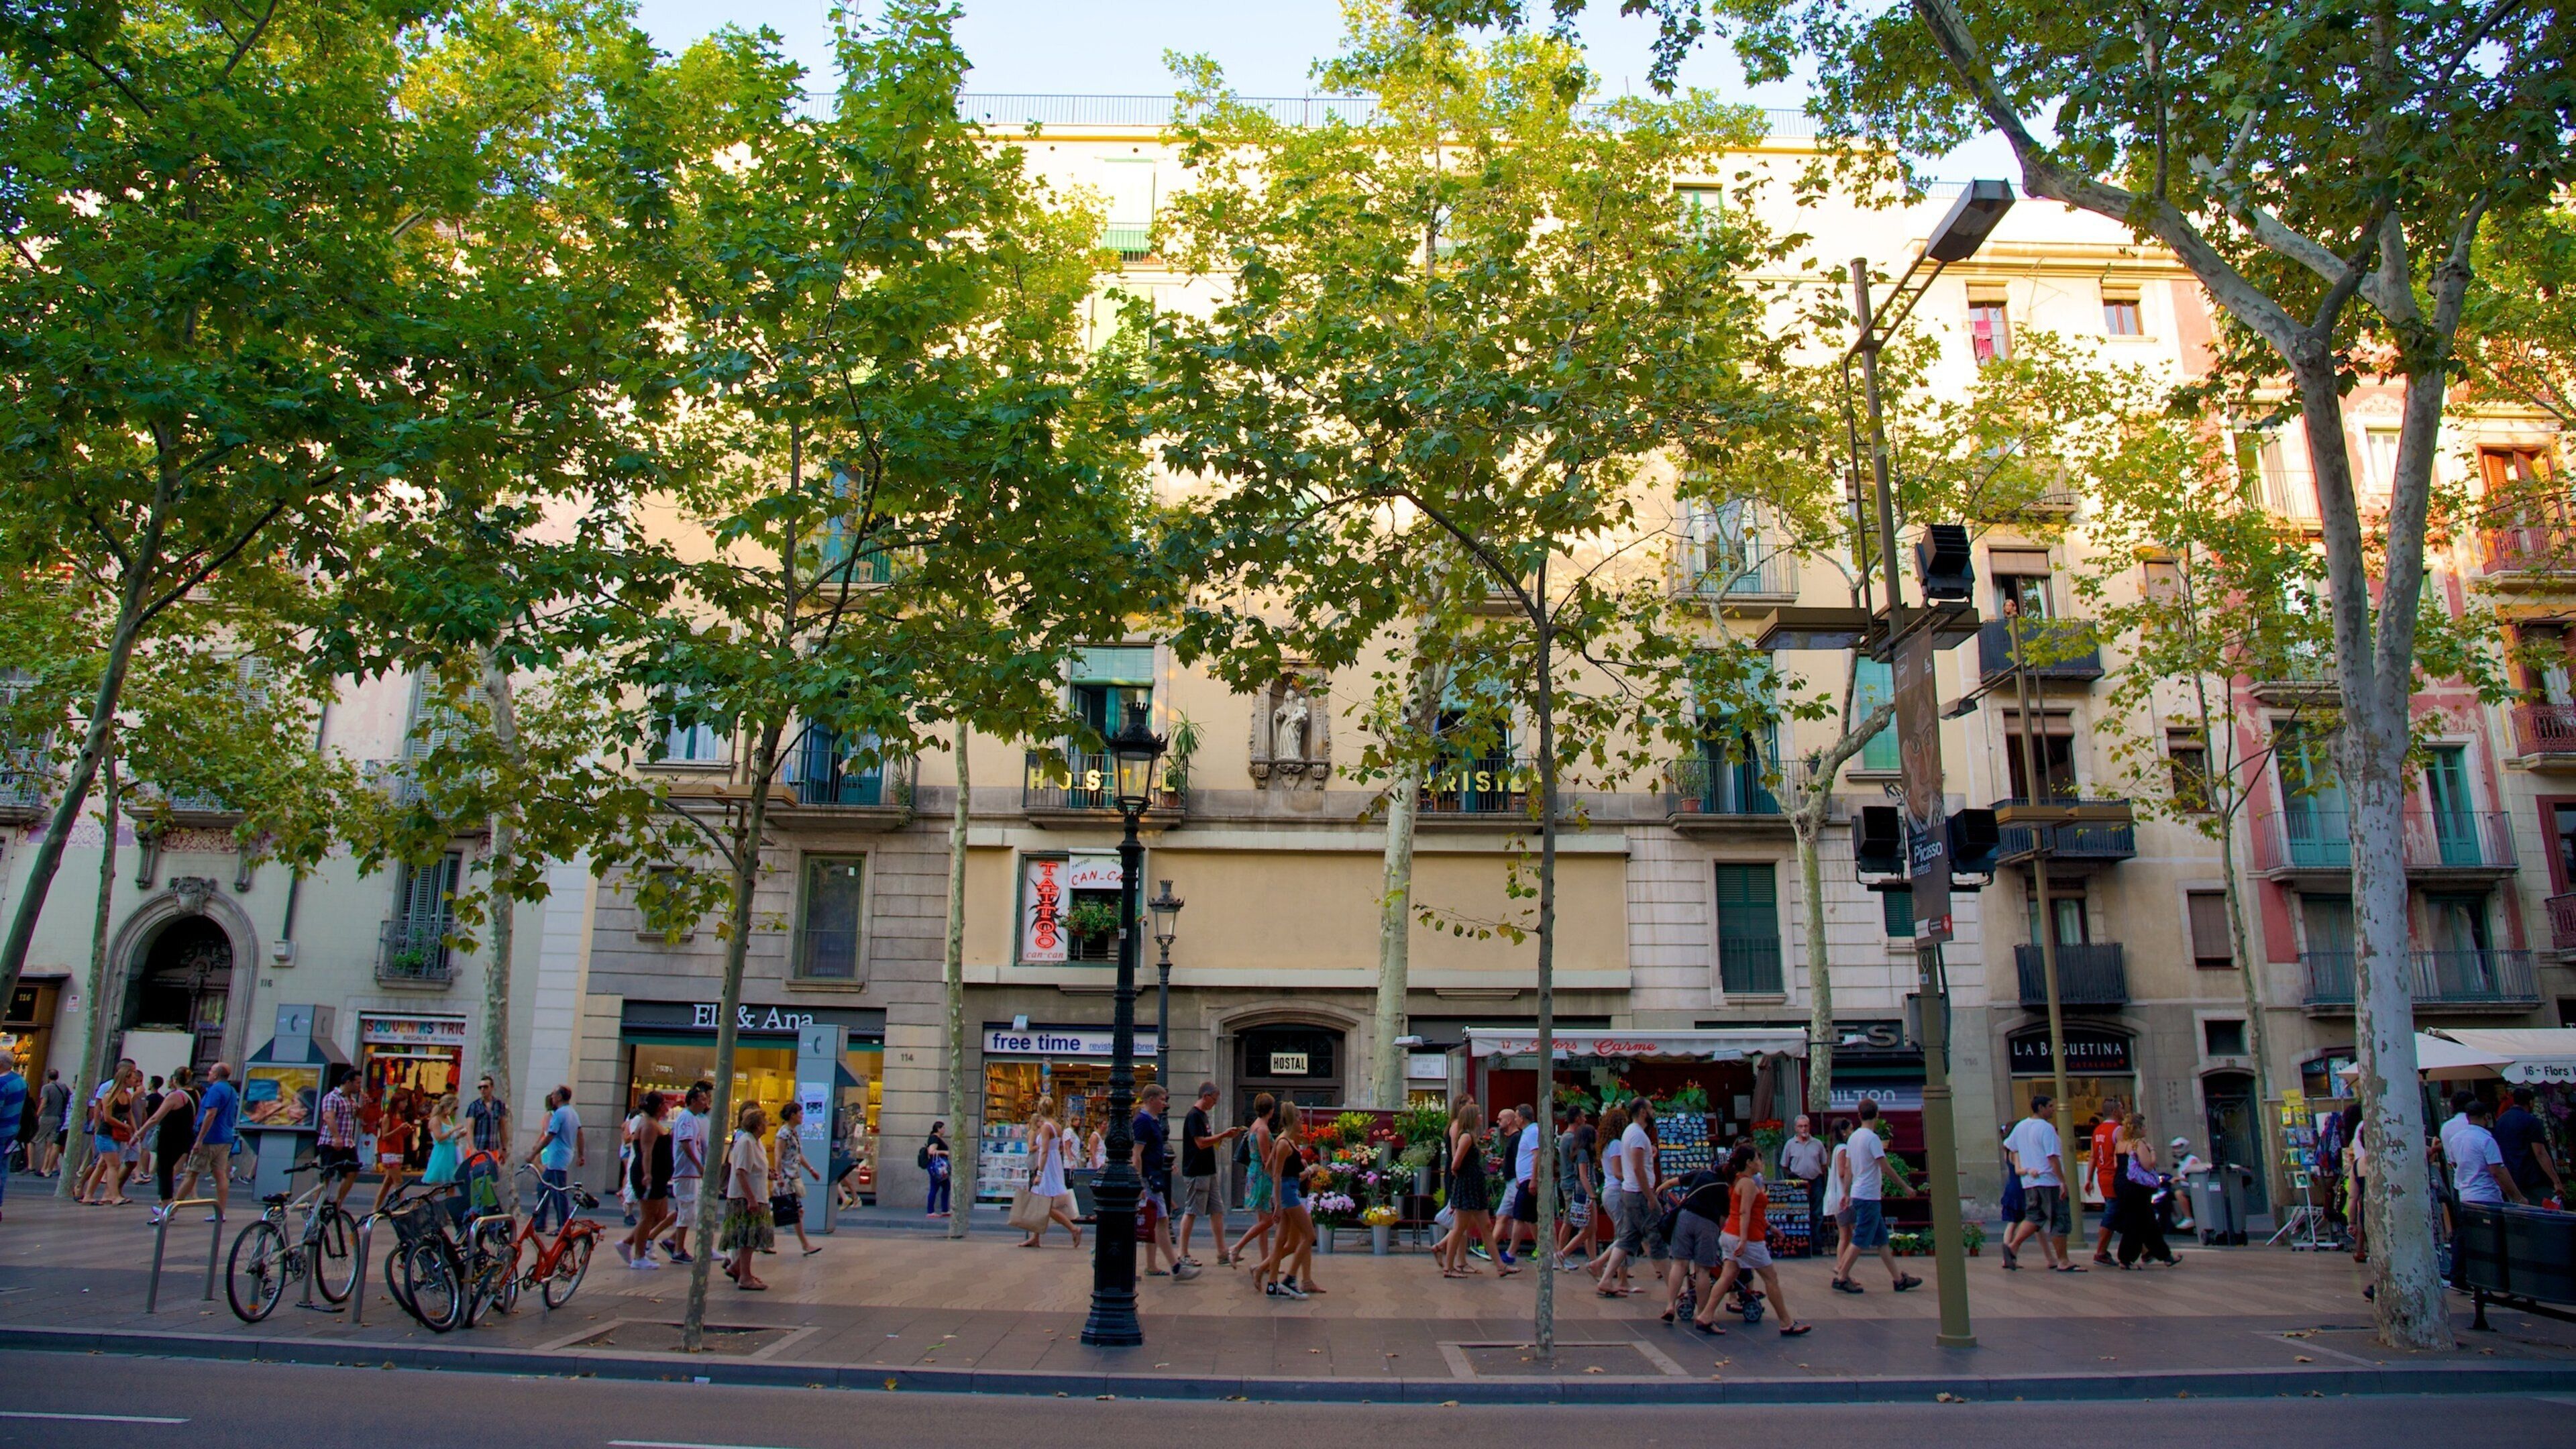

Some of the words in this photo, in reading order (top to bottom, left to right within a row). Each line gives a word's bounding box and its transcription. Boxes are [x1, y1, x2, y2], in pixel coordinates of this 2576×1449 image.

[1914, 841, 1943, 864] Picasso
[1072, 858, 1091, 869] TATTOO
[1035, 861, 1059, 948] TATTOO
[260, 979, 272, 987] 116
[693, 1004, 719, 1027] El
[737, 1005, 755, 1028] &
[761, 1006, 814, 1030] Ana
[993, 1033, 1031, 1050] free
[1038, 1034, 1081, 1051] time
[1593, 1039, 1657, 1054] Carme
[2014, 1041, 2033, 1056] LA
[900, 1053, 914, 1062] 114
[1273, 1057, 1305, 1070] HOSTAL
[2524, 1066, 2534, 1075] 16
[2544, 1065, 2569, 1076] Flors
